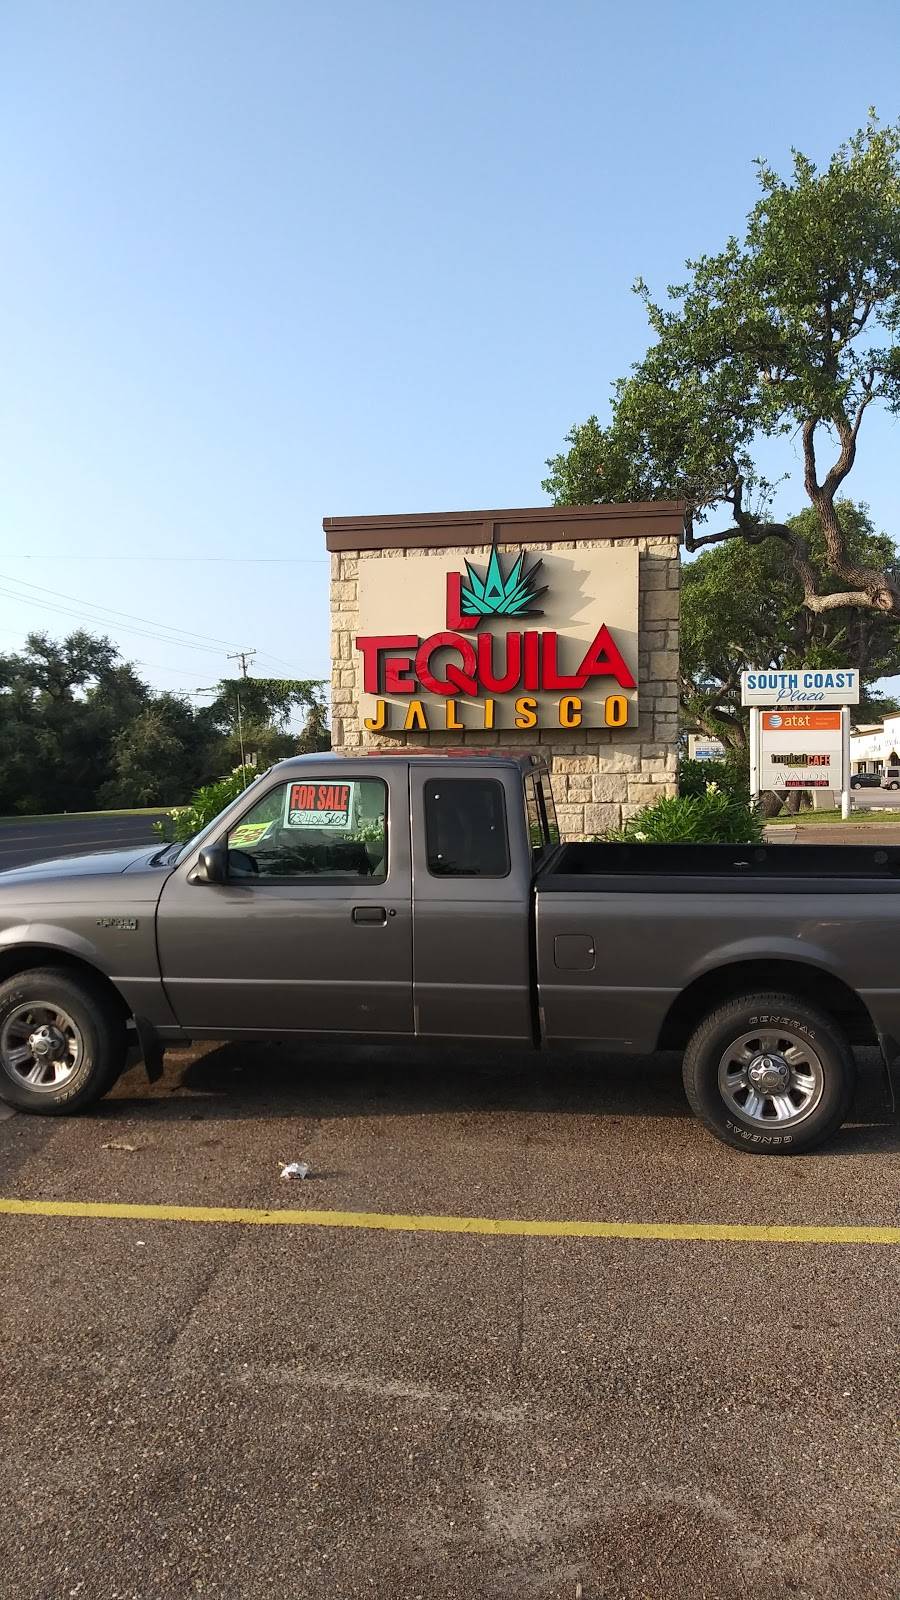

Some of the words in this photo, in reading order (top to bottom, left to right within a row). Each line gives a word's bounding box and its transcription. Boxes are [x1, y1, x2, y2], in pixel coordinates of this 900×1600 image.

[355, 622, 637, 697] TEQUILA
[747, 673, 798, 689] SOUTH
[803, 672, 855, 689] COAST
[776, 688, 826, 702] Plaza
[364, 694, 629, 731] JALISCO
[784, 715, 811, 727] at&t
[807, 754, 830, 766] CAFE
[290, 785, 316, 810] FOR
[317, 785, 349, 811] SALE
[749, 1015, 816, 1040] GENERAL
[726, 1120, 793, 1144] GENERAL
